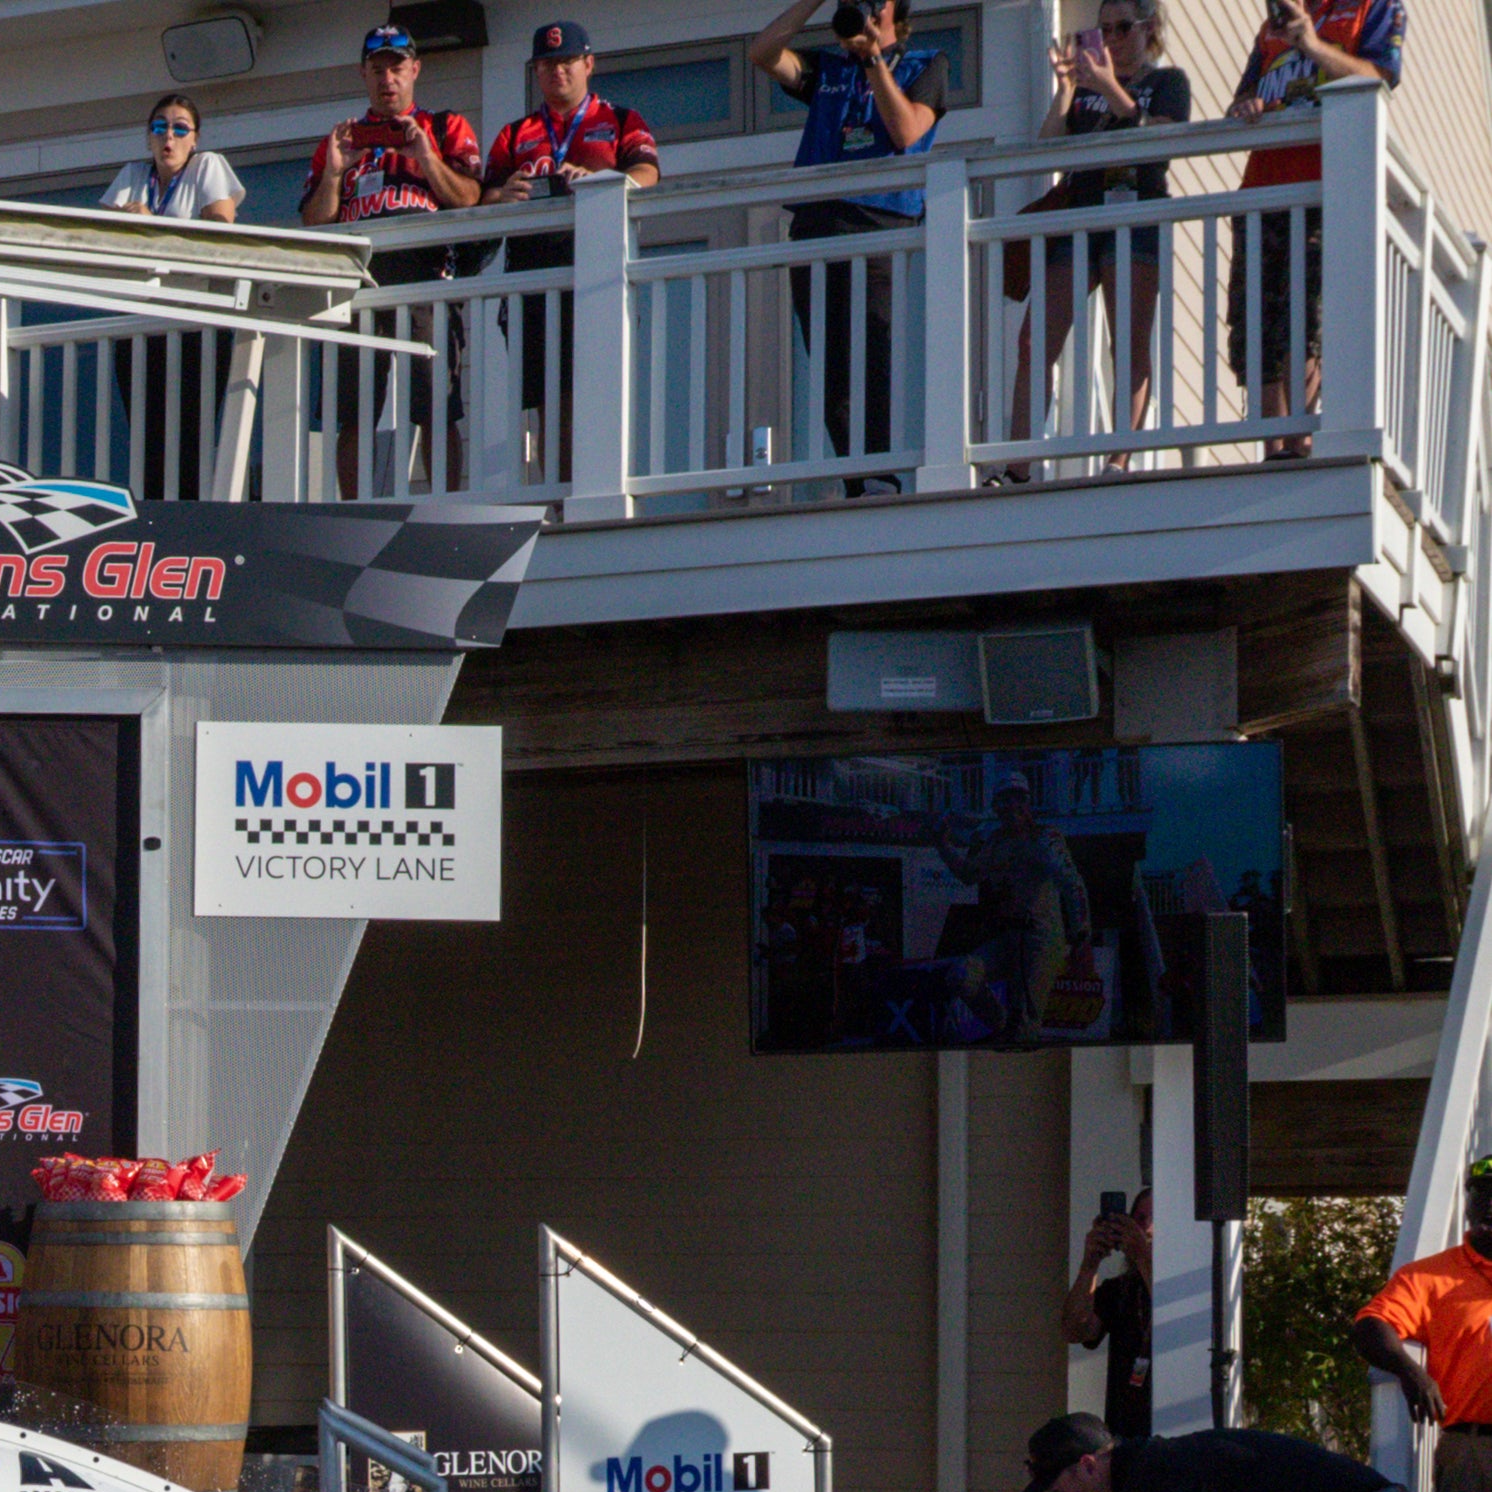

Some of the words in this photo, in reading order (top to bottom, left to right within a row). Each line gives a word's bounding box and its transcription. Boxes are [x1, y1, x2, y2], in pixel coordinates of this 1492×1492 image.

[82, 539, 228, 601] Glen
[234, 758, 392, 809] Mobil
[234, 852, 366, 881] VICTORY
[374, 855, 457, 882] LANE
[18, 1104, 84, 1134] Glen
[36, 1322, 190, 1353] GLENORA
